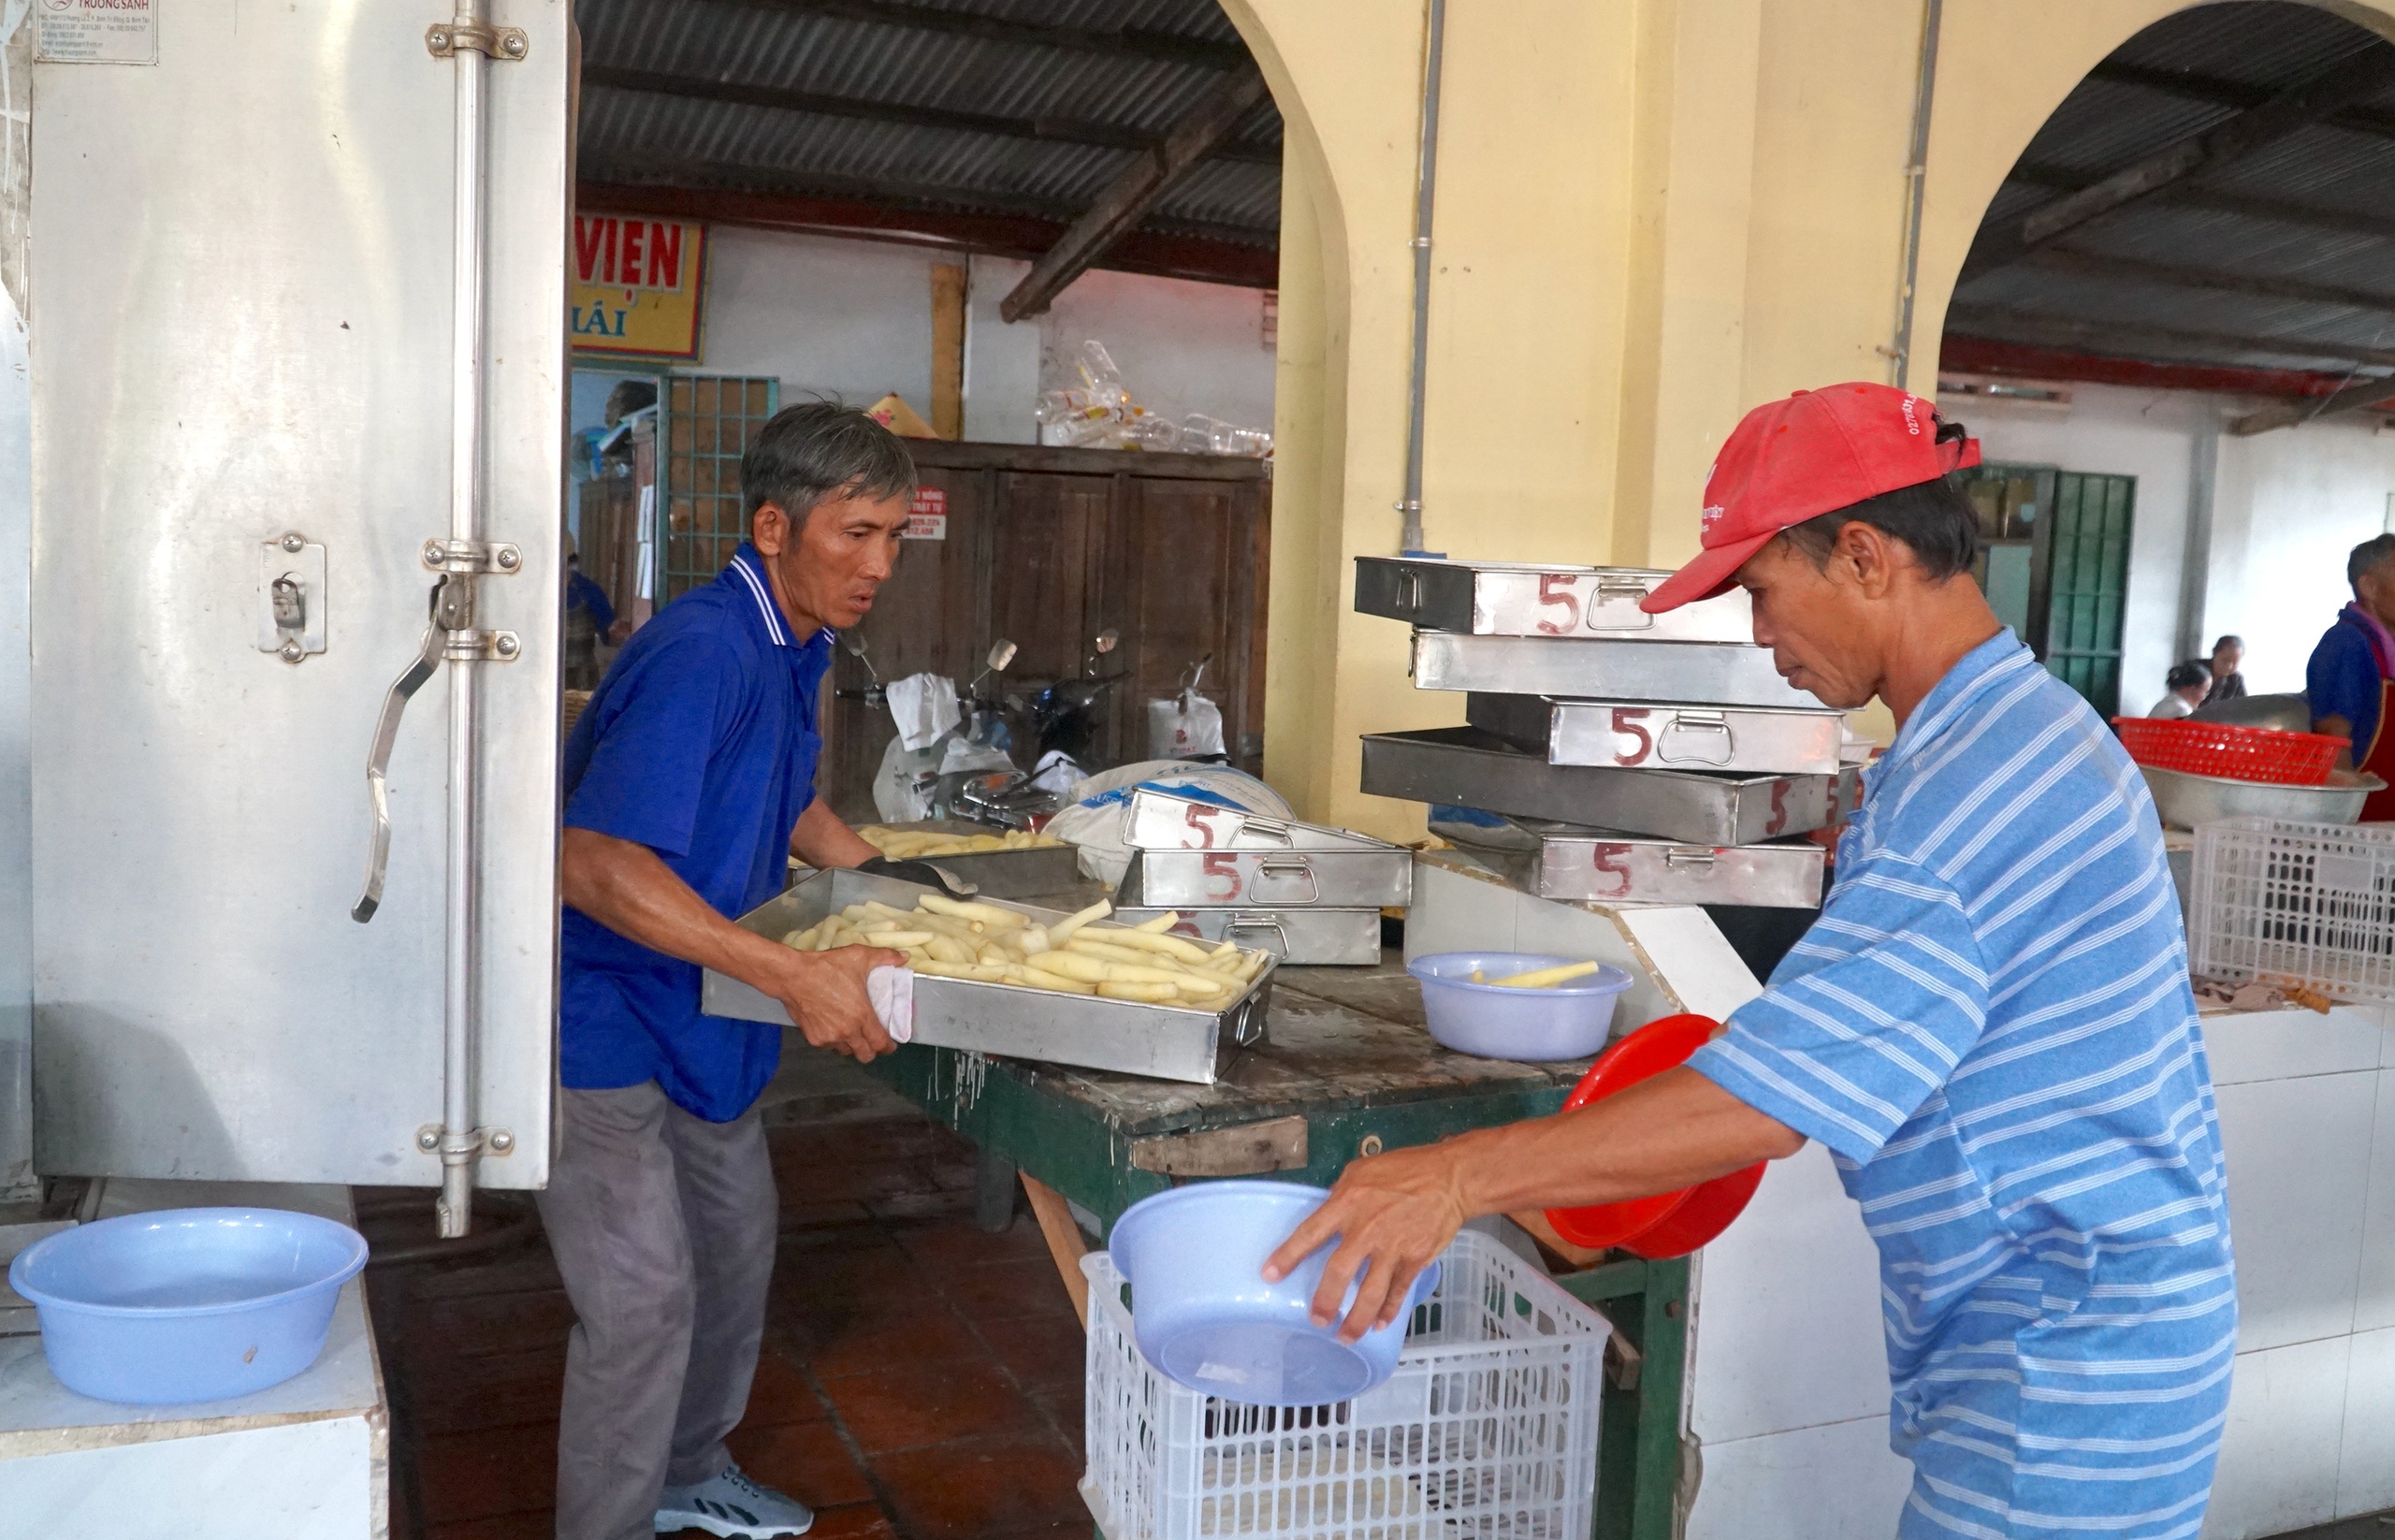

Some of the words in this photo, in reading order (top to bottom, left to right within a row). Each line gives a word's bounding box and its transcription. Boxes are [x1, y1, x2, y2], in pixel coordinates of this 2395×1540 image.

[1538, 574, 1580, 633] 5
[1612, 707, 1653, 766] 5
[1182, 804, 1221, 850] 5
[1765, 779, 1791, 835] 5
[1202, 852, 1242, 902] 5
[1593, 842, 1633, 897] 5
